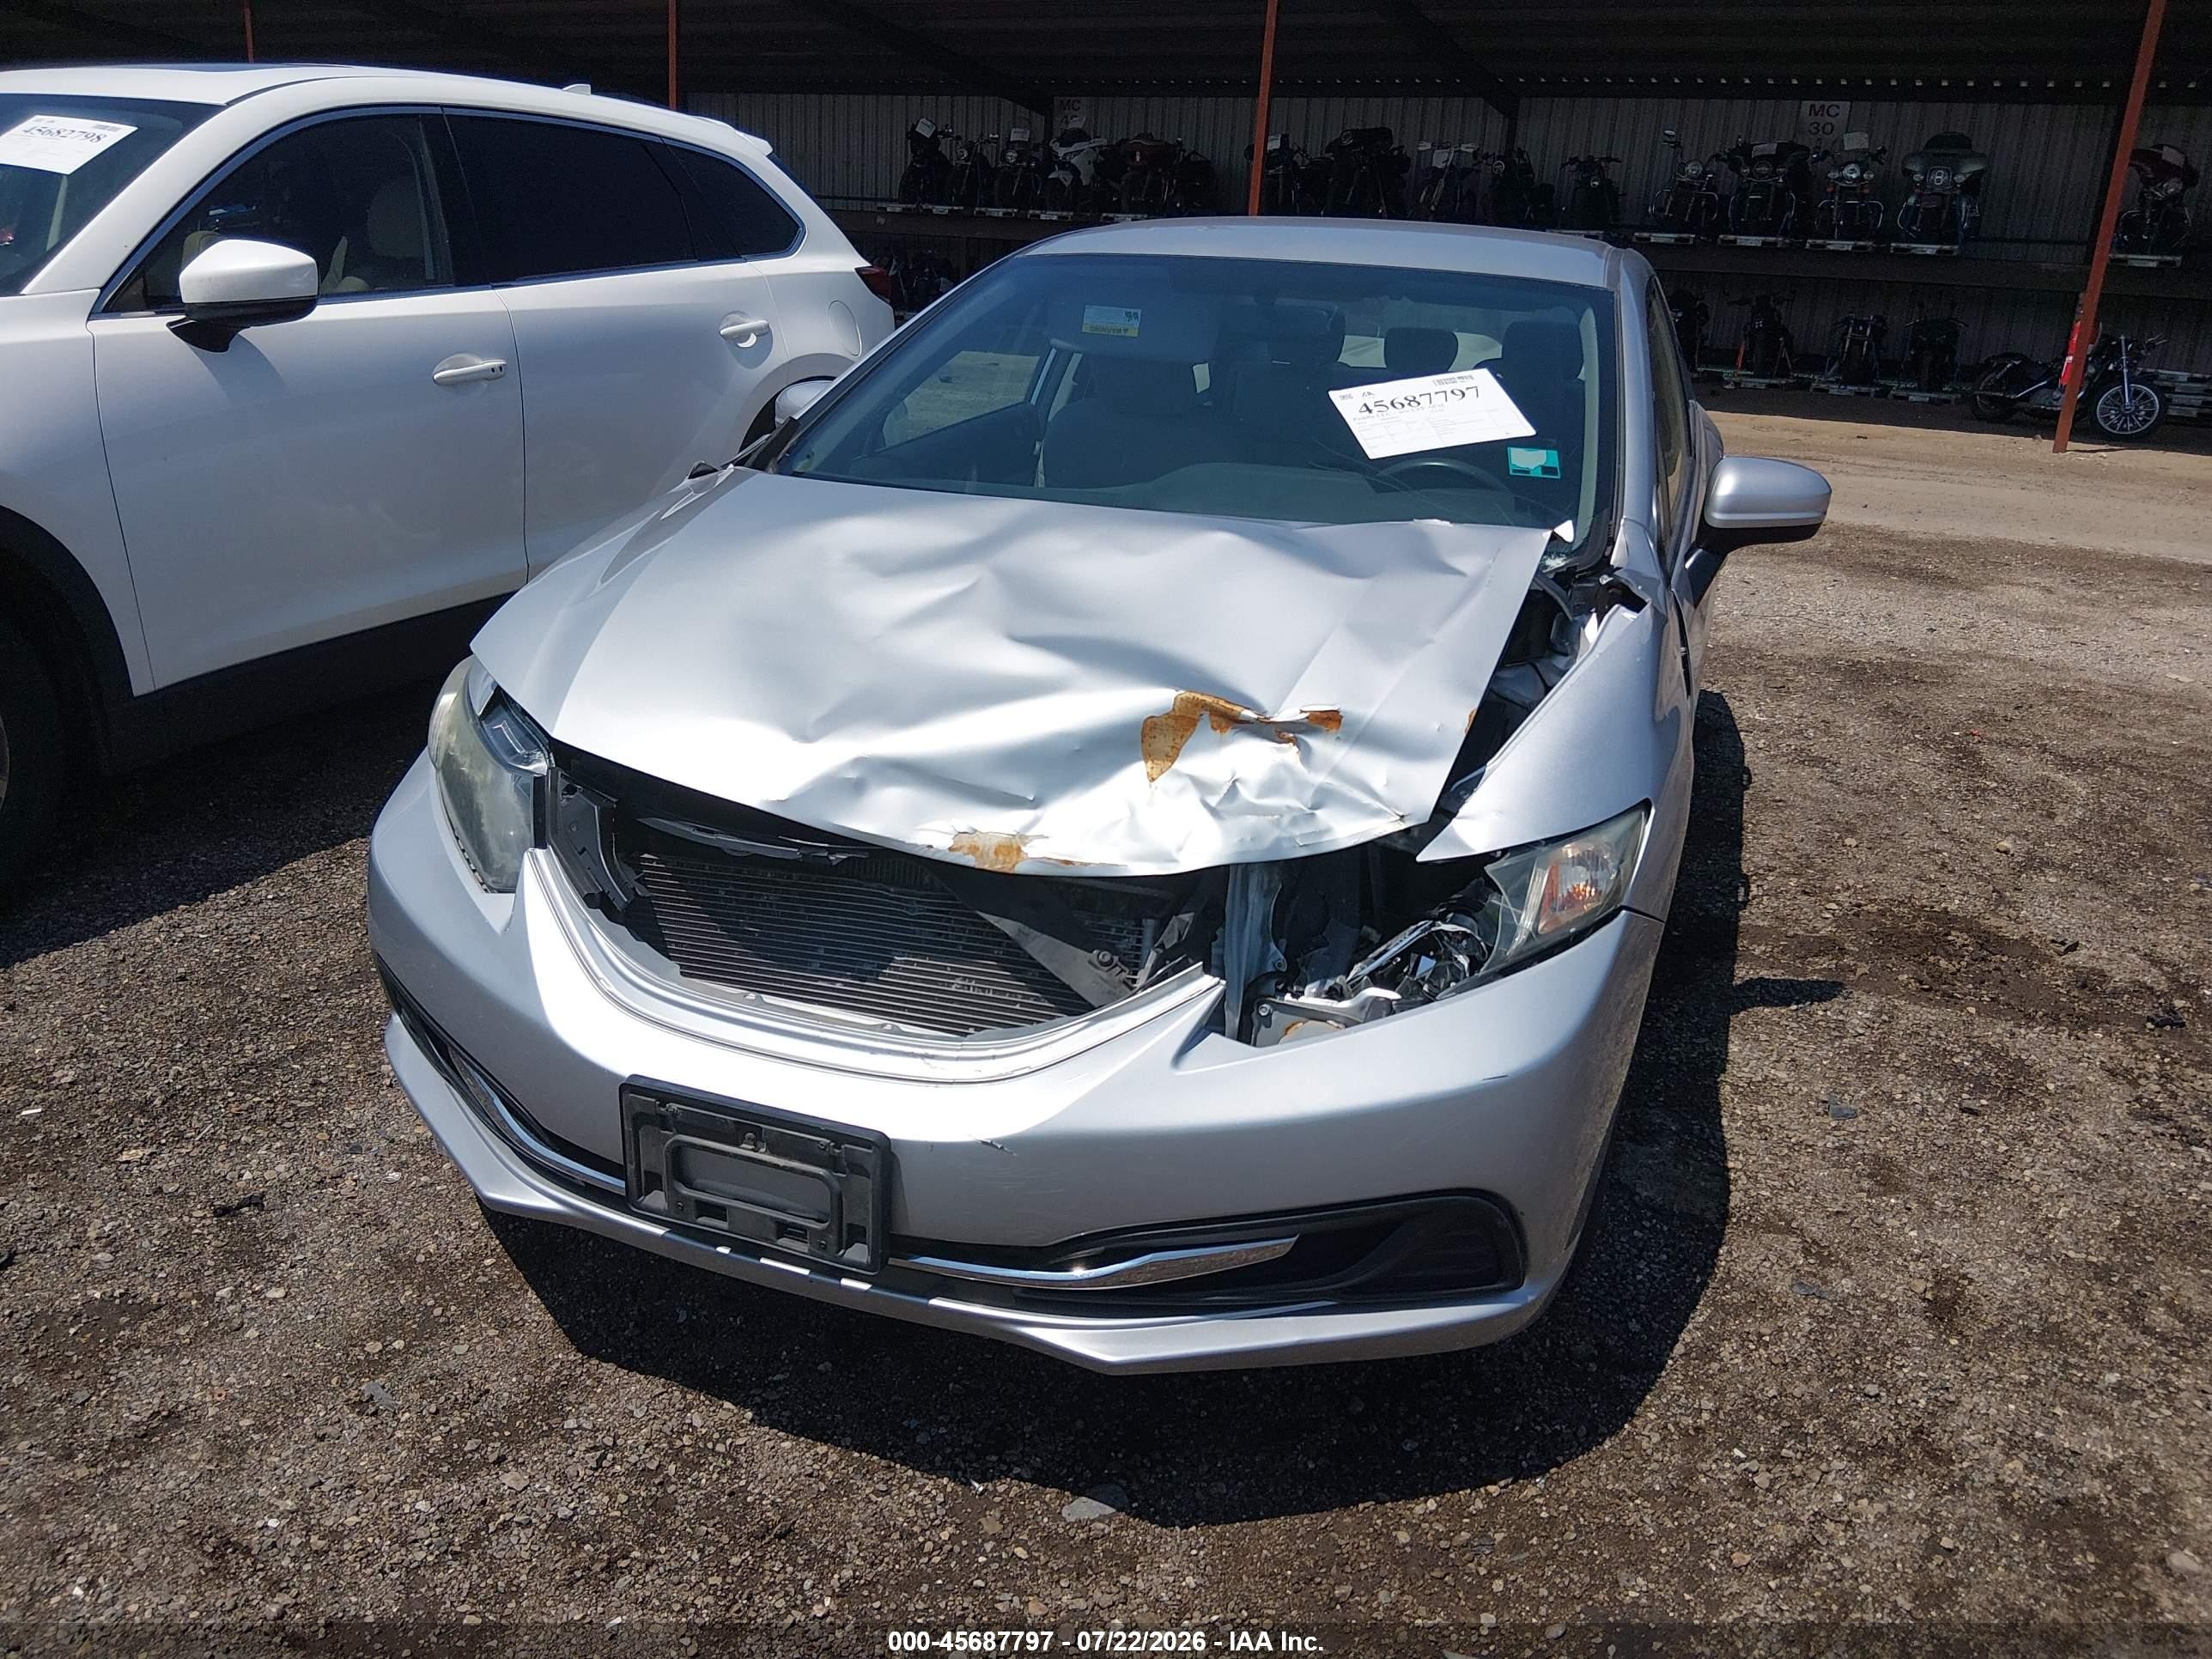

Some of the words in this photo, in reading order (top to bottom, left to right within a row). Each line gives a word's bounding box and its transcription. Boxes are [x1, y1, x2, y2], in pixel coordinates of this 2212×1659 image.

[1059, 99, 1081, 112] MC
[1808, 104, 1840, 118] MC
[1808, 121, 1835, 136] 30
[1358, 386, 1480, 414] 45687797
